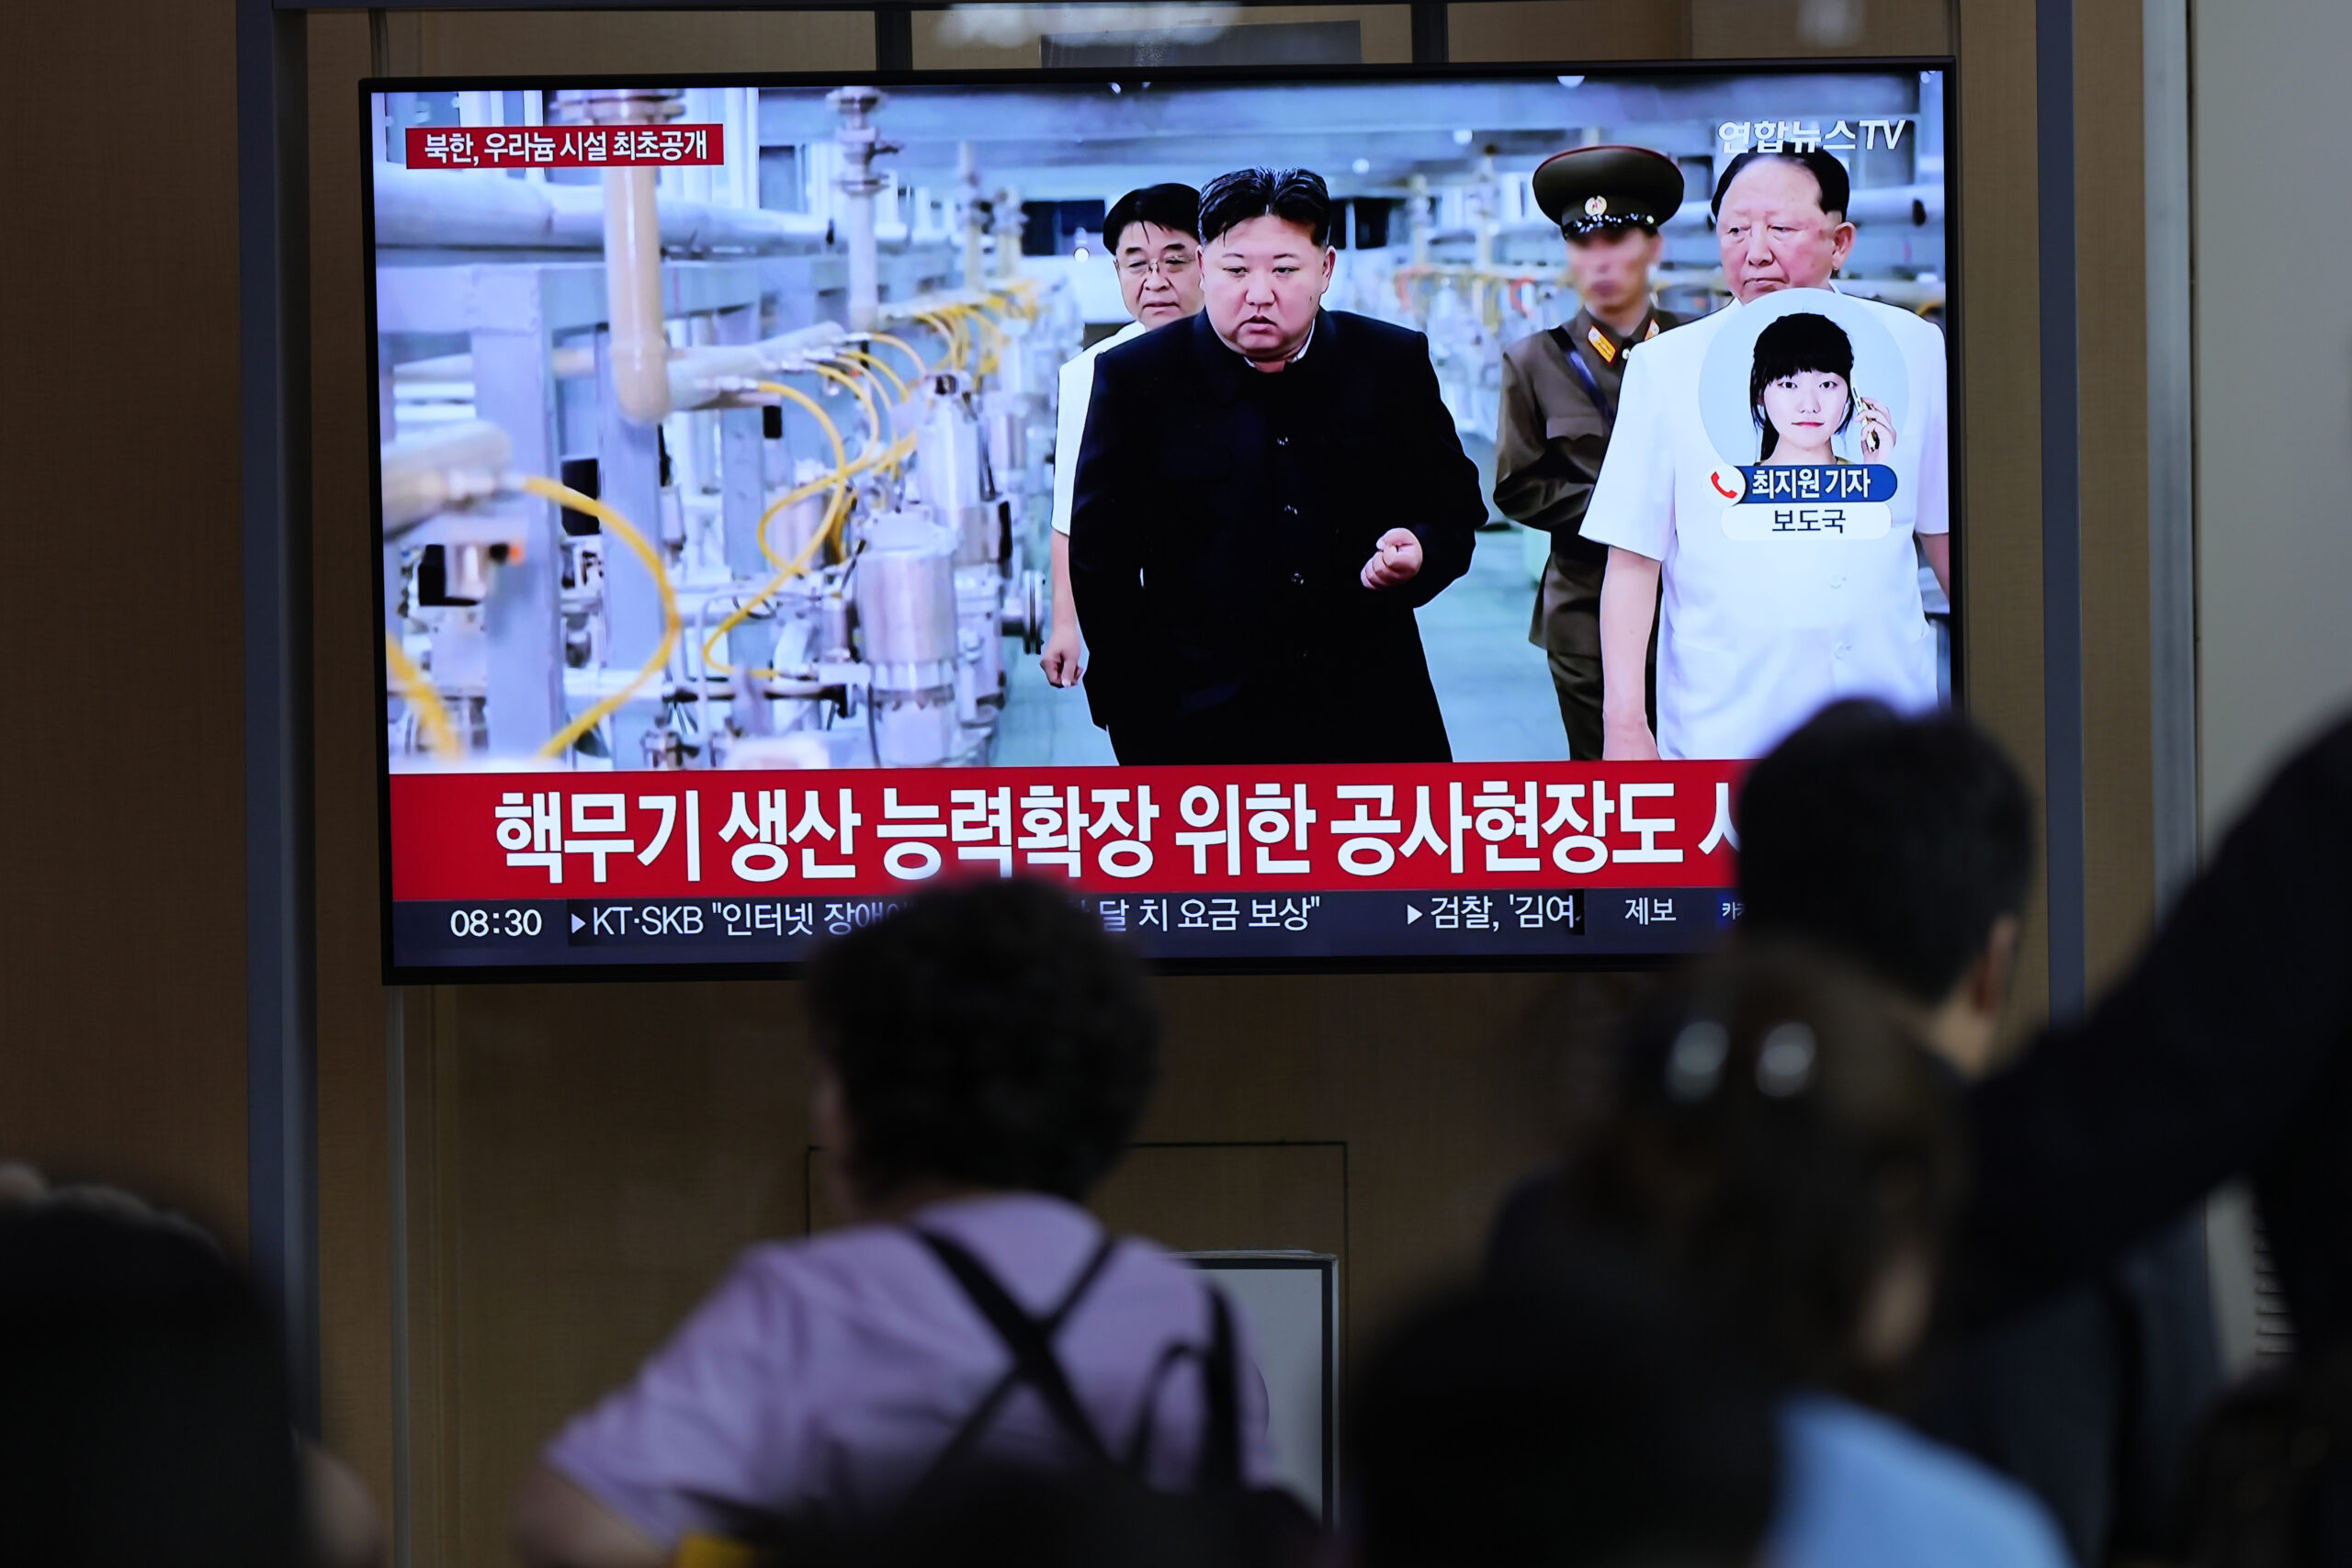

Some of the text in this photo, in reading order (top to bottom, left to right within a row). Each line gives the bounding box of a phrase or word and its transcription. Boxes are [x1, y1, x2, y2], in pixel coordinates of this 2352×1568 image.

[424, 130, 707, 166] 북한, 우라늄 시설 최초공개
[1718, 119, 1906, 153] 연합뉴스TV
[1752, 468, 1871, 499] 최지원 기자
[1771, 509, 1847, 534] 보도국
[494, 790, 701, 884] 핵무기
[718, 788, 863, 882] 생산
[876, 784, 1160, 880] 능력확장
[1175, 783, 1317, 876] 위한
[1329, 780, 1684, 876] 공사현장도
[449, 908, 543, 937] 08:30
[593, 906, 705, 935] KT·SKB
[712, 901, 814, 936] "인터넷
[824, 901, 910, 935] 장애
[1098, 898, 1130, 932] 달
[1138, 897, 1170, 931] 치
[1178, 898, 1241, 931] 요금
[1248, 897, 1321, 931] 보상"
[1430, 894, 1582, 932] 검찰, '김여
[1624, 897, 1677, 926] 제보
